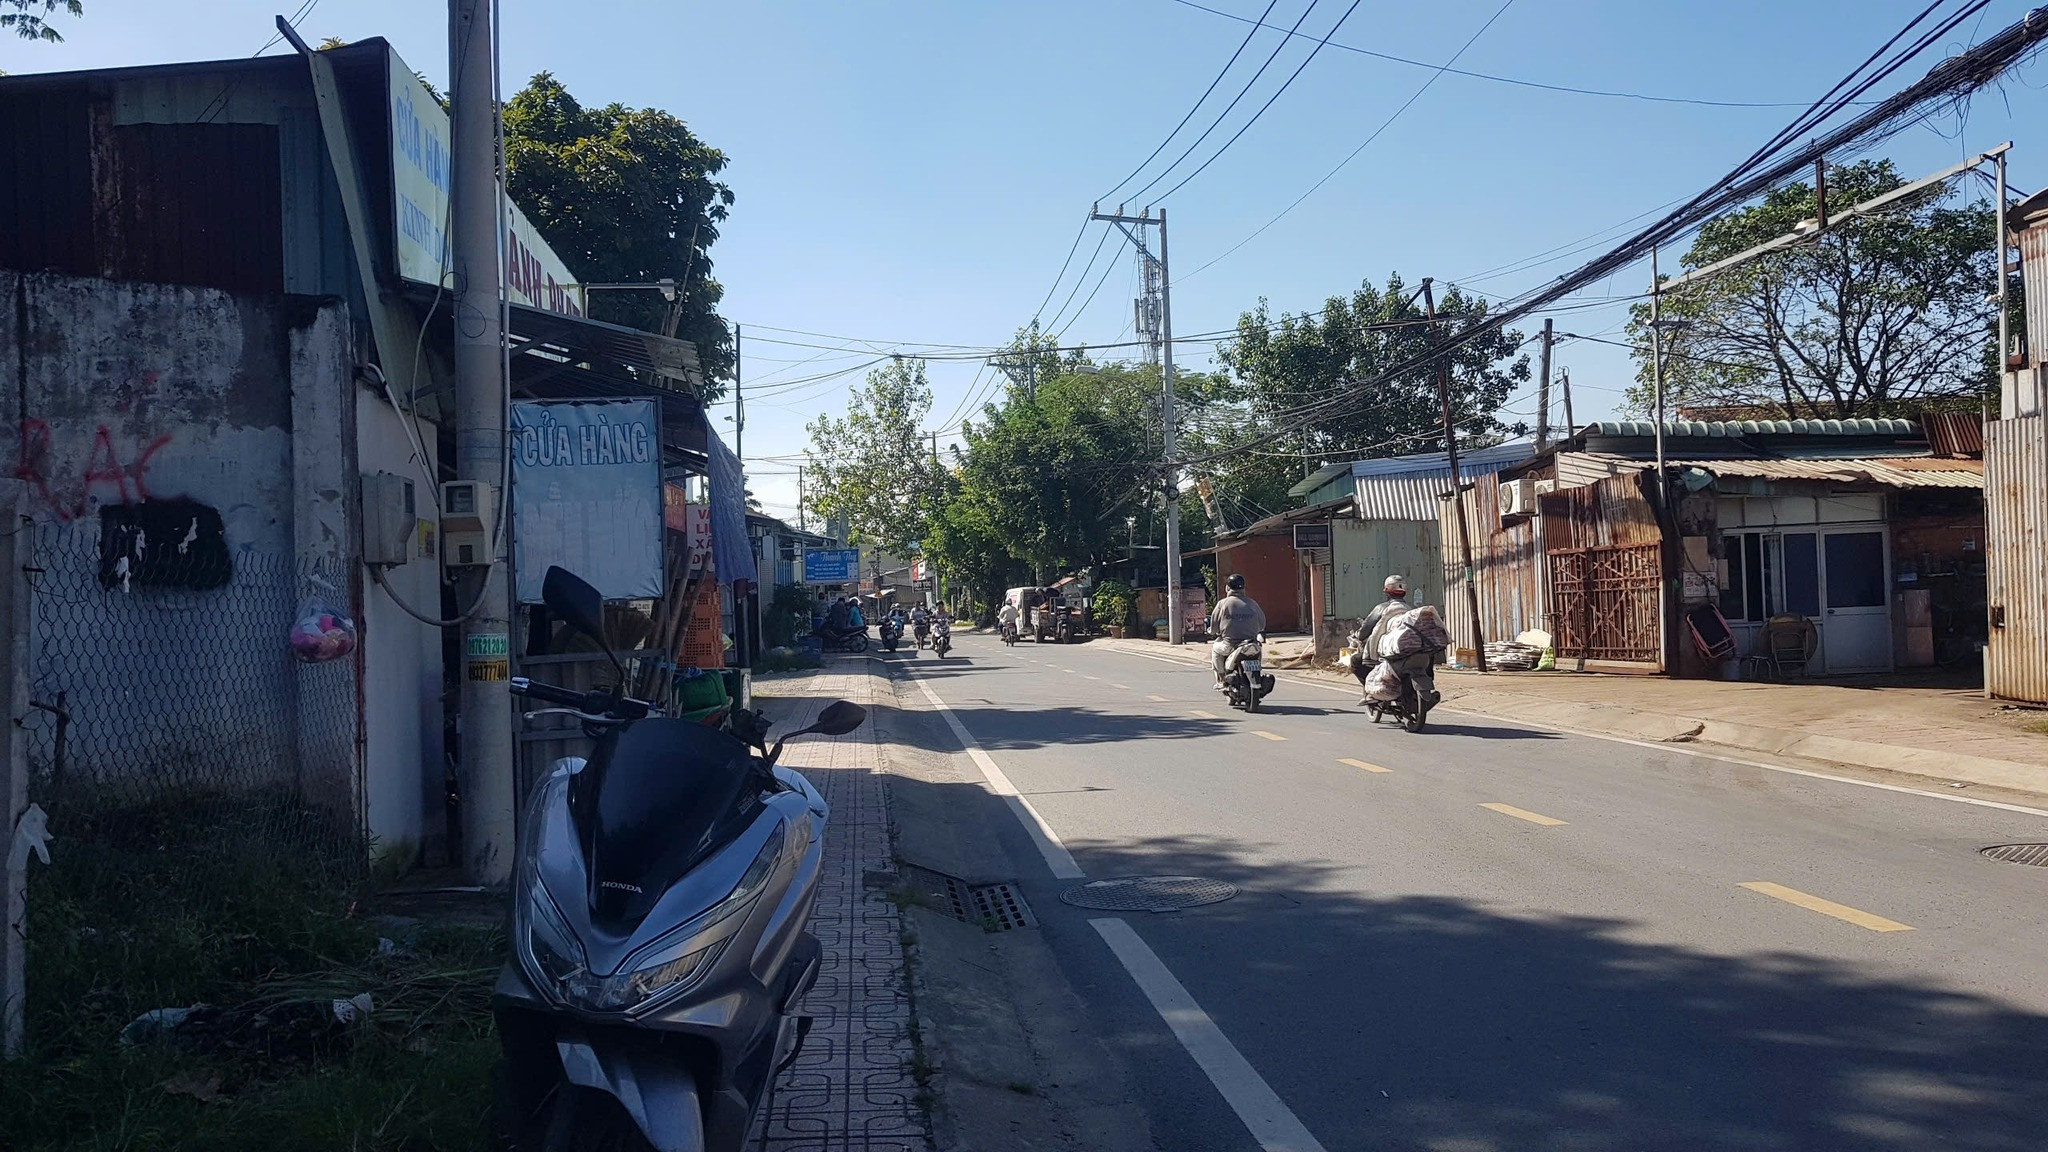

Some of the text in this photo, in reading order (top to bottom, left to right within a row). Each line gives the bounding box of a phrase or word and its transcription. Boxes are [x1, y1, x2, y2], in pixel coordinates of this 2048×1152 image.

[425, 124, 450, 195] HÀN
[521, 410, 649, 467] CỬA HÀNG
[601, 881, 642, 893] HONDA
